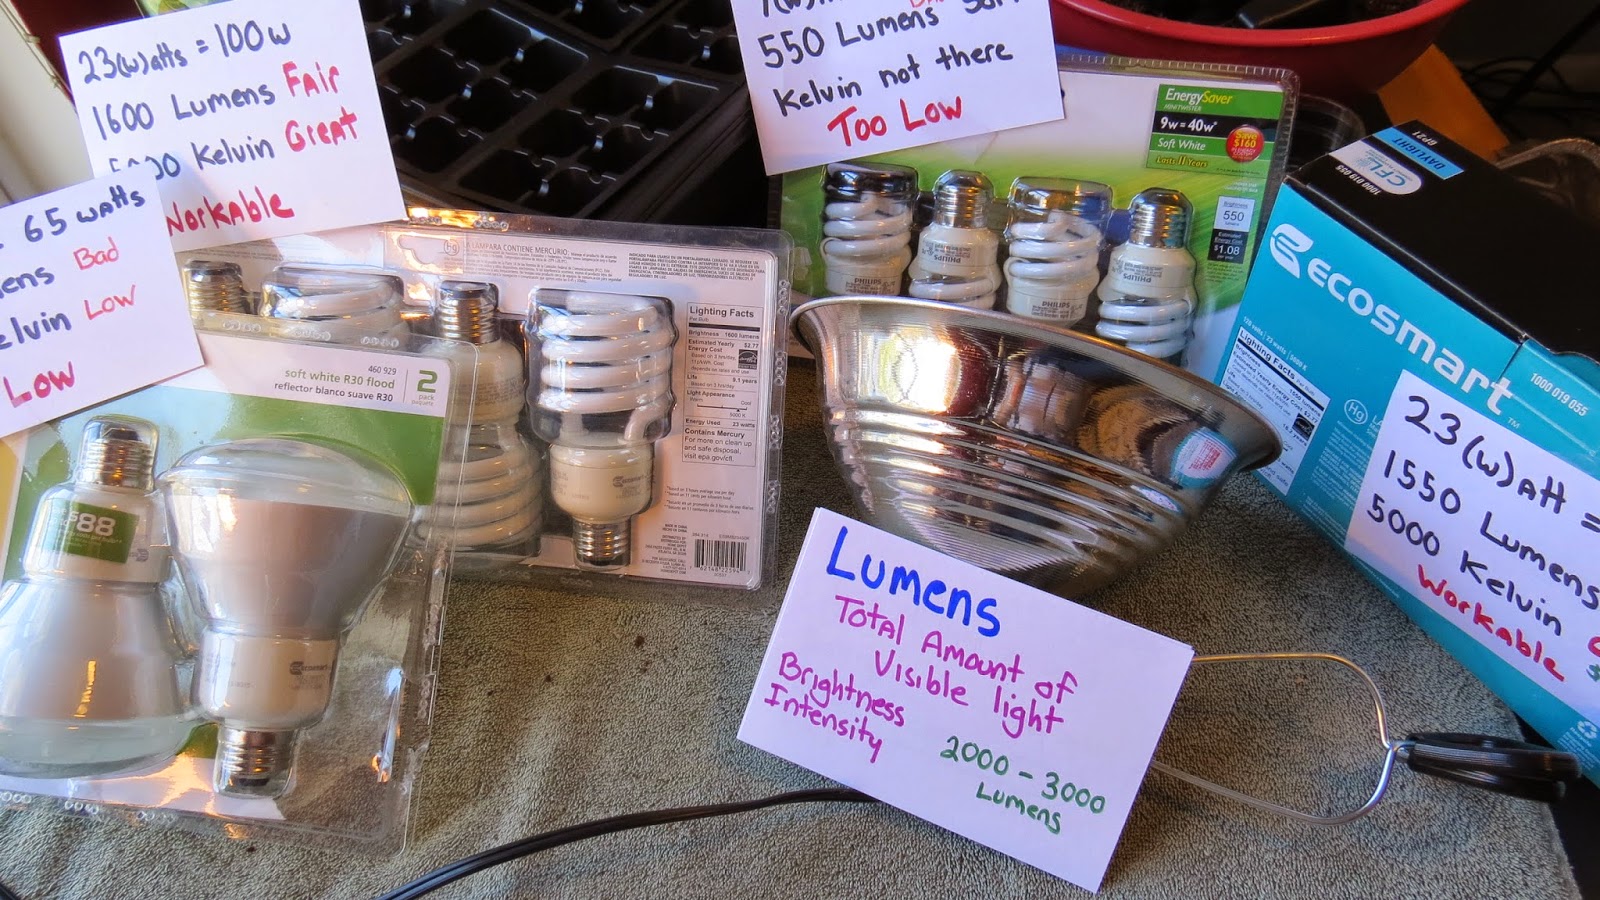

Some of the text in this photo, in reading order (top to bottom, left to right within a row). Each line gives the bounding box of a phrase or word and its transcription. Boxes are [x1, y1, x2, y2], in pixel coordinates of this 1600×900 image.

[758, 27, 824, 68] 550
[835, 7, 939, 46] Lumens
[773, 44, 1013, 116] Kelvin not there
[92, 102, 154, 140] 1600
[171, 82, 275, 120] Lumens
[827, 96, 962, 146] Too Low
[1157, 138, 1206, 151] Soft White
[1234, 139, 1256, 148] $160
[1236, 131, 1257, 140] Save
[191, 136, 275, 170] Kelvin
[1156, 156, 1176, 165] Lasts
[1188, 158, 1207, 168] Years
[1392, 138, 1445, 169] DAYLIGHT
[1369, 156, 1406, 186] CFL
[24, 207, 67, 242] 65
[1223, 211, 1244, 221] 550
[73, 236, 120, 271] Bad
[934, 255, 961, 263] PHILIPS
[1214, 245, 1240, 255] $1.08
[1123, 273, 1152, 283] PHILIPS
[690, 306, 754, 317] Lighting Facts
[1240, 330, 1295, 380] Lighting Facts
[1272, 340, 1287, 355] watts
[285, 369, 395, 389] soft white R30 flood
[368, 365, 397, 375] 460 929
[417, 370, 438, 393] 2
[1227, 368, 1236, 378] Life
[1233, 351, 1256, 372] Estimated
[1257, 371, 1271, 386] Yearly
[1273, 384, 1289, 401] Energy
[1291, 400, 1303, 411] Cost
[1236, 343, 1321, 417] Brightness lumens
[274, 382, 393, 402] reflector blanco suave R30
[1530, 373, 1588, 416] 1000 019 055
[1348, 402, 1365, 422] Hg
[717, 430, 745, 439] Mercury
[1293, 433, 1307, 446] years
[1384, 450, 1461, 515] 1550
[1480, 510, 1600, 610] Lumens
[1366, 493, 1440, 556] 5000
[1460, 549, 1562, 636] Kelvin
[825, 526, 1002, 638] Lumens
[1417, 563, 1565, 682] Workable
[835, 594, 1079, 703] Total Amount of
[778, 651, 905, 728] Brightness
[874, 648, 1065, 739] Visible light
[764, 682, 883, 764] Intensity
[940, 735, 1010, 777] 2000
[1041, 770, 1106, 815] 3000
[975, 781, 1063, 836] Lumens
